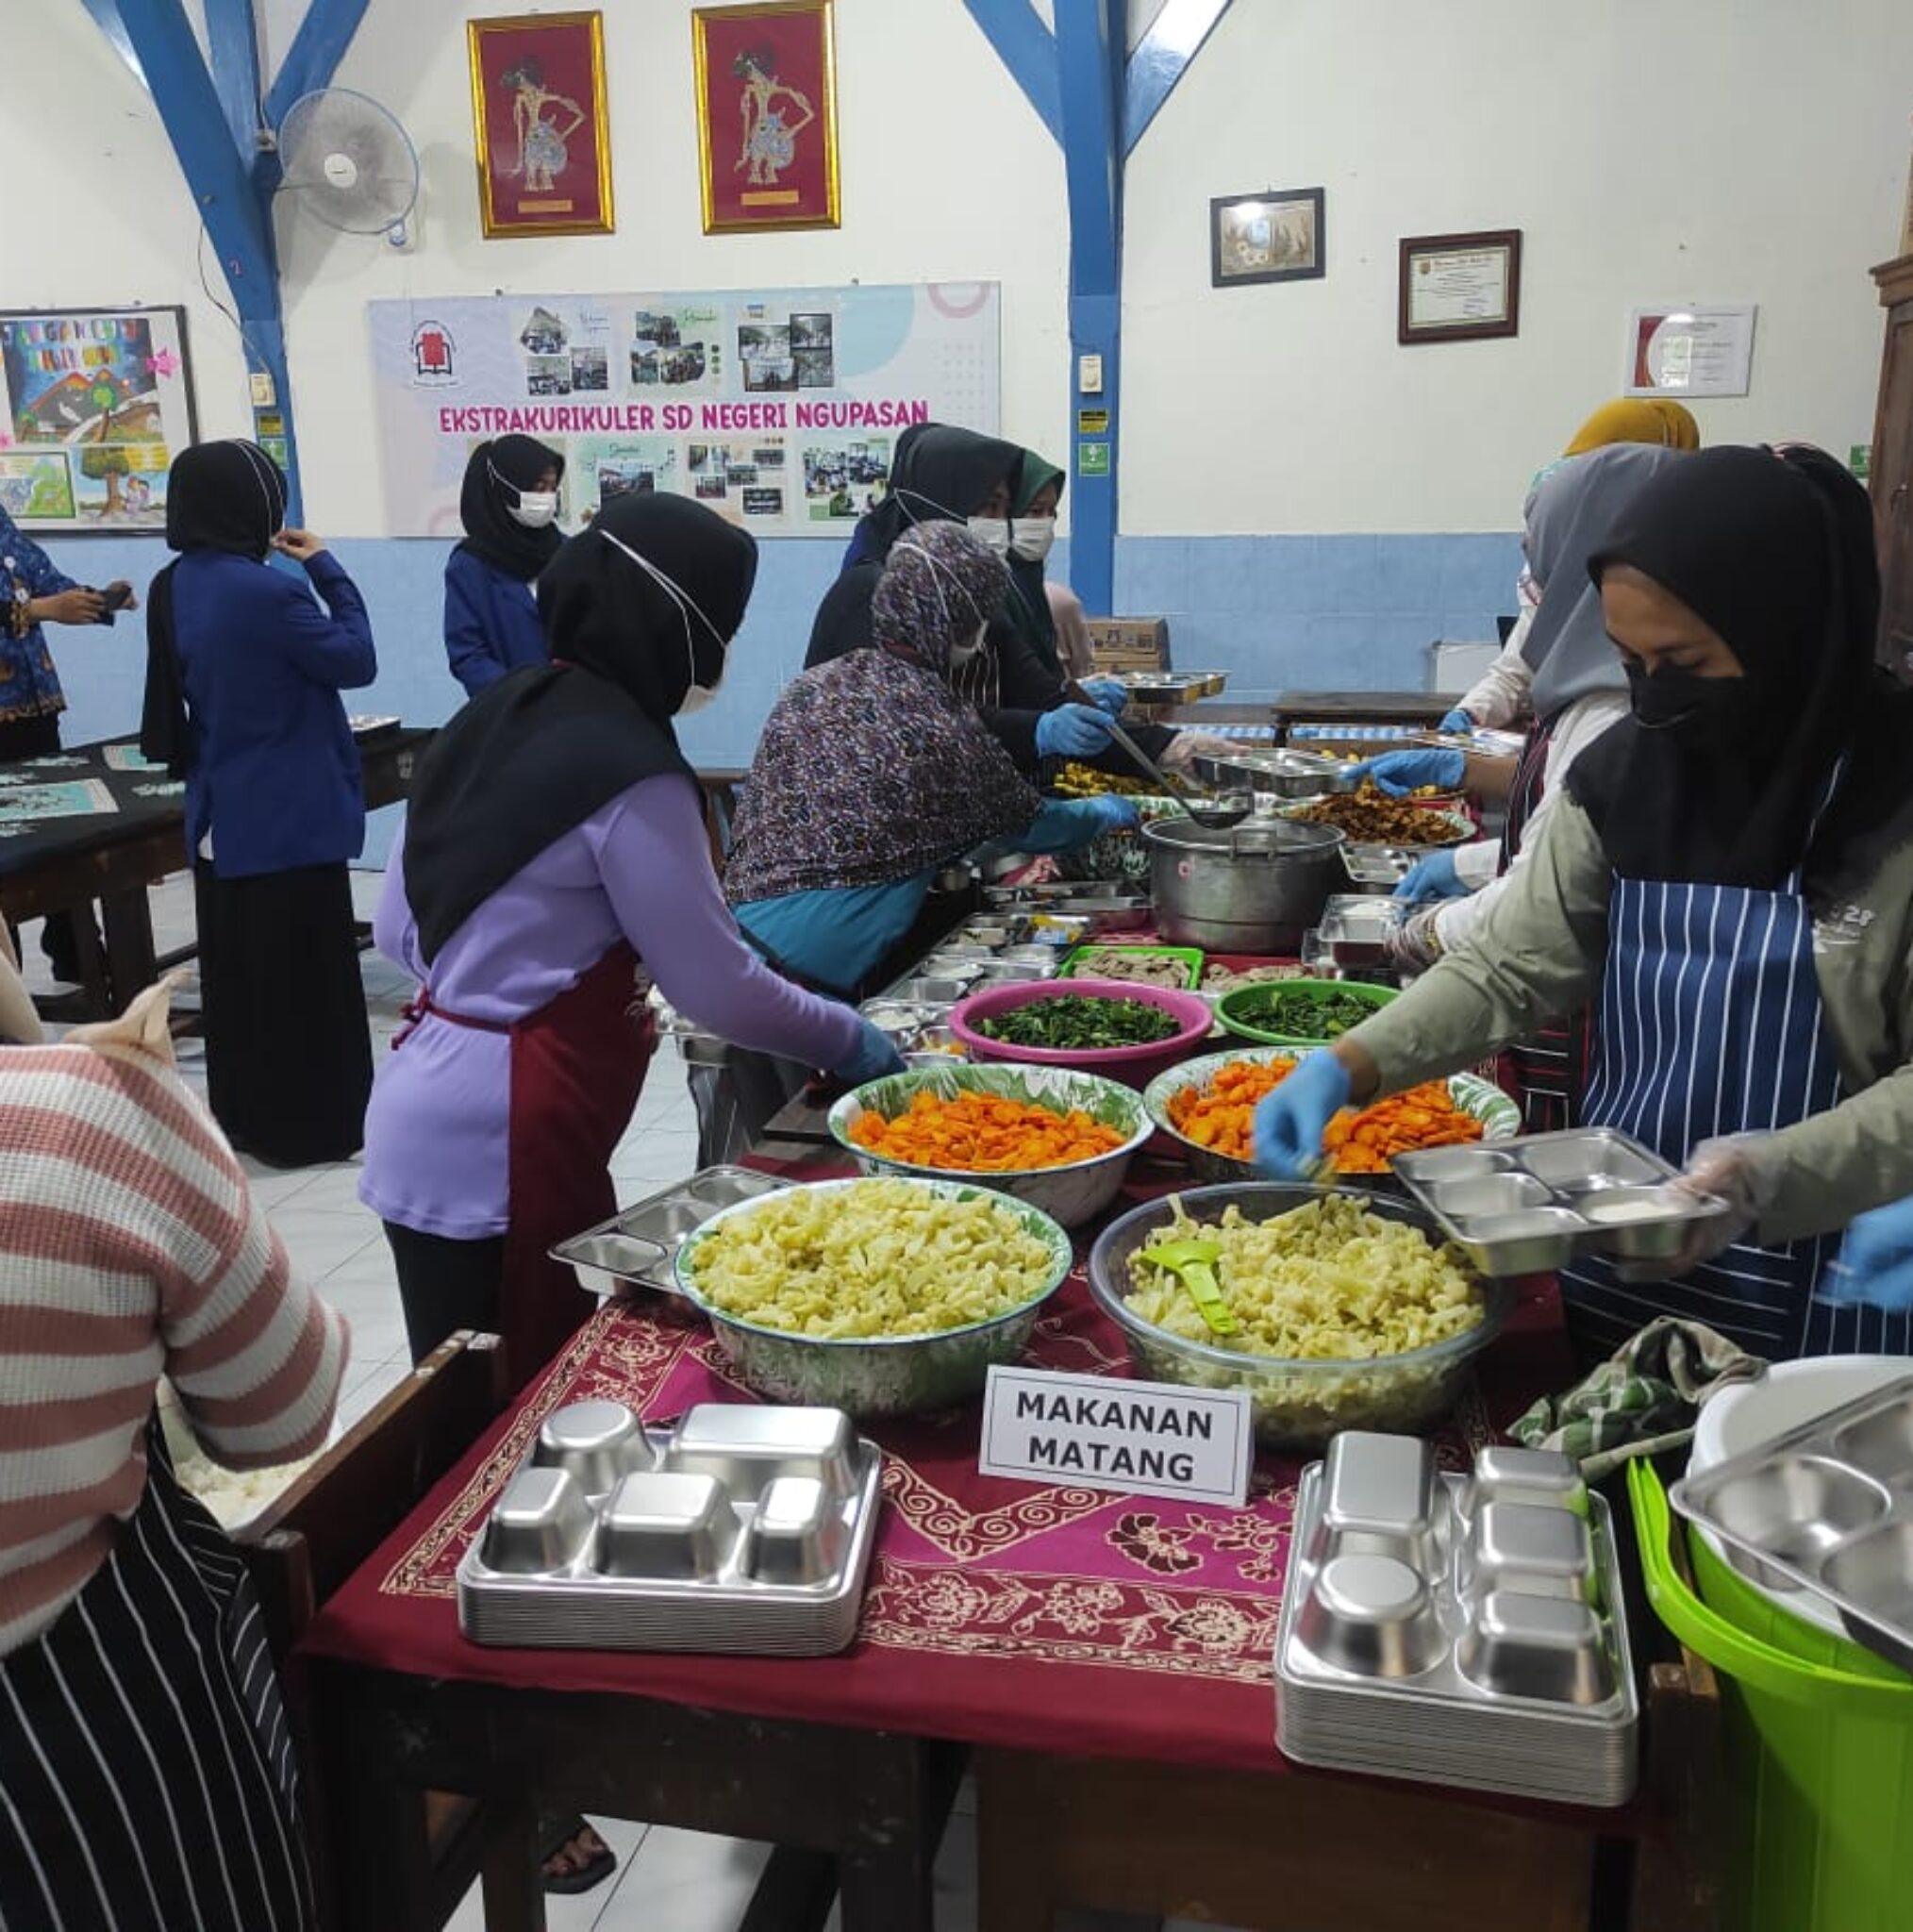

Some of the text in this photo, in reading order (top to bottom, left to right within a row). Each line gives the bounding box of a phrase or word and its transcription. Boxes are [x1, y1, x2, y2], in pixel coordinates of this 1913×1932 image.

[440, 400, 929, 432] EKSTRAKURIKULER SD NEGERI NGUPASAN
[1016, 1391, 1213, 1441] MAKANAN
[1028, 1435, 1195, 1483] MATANG
